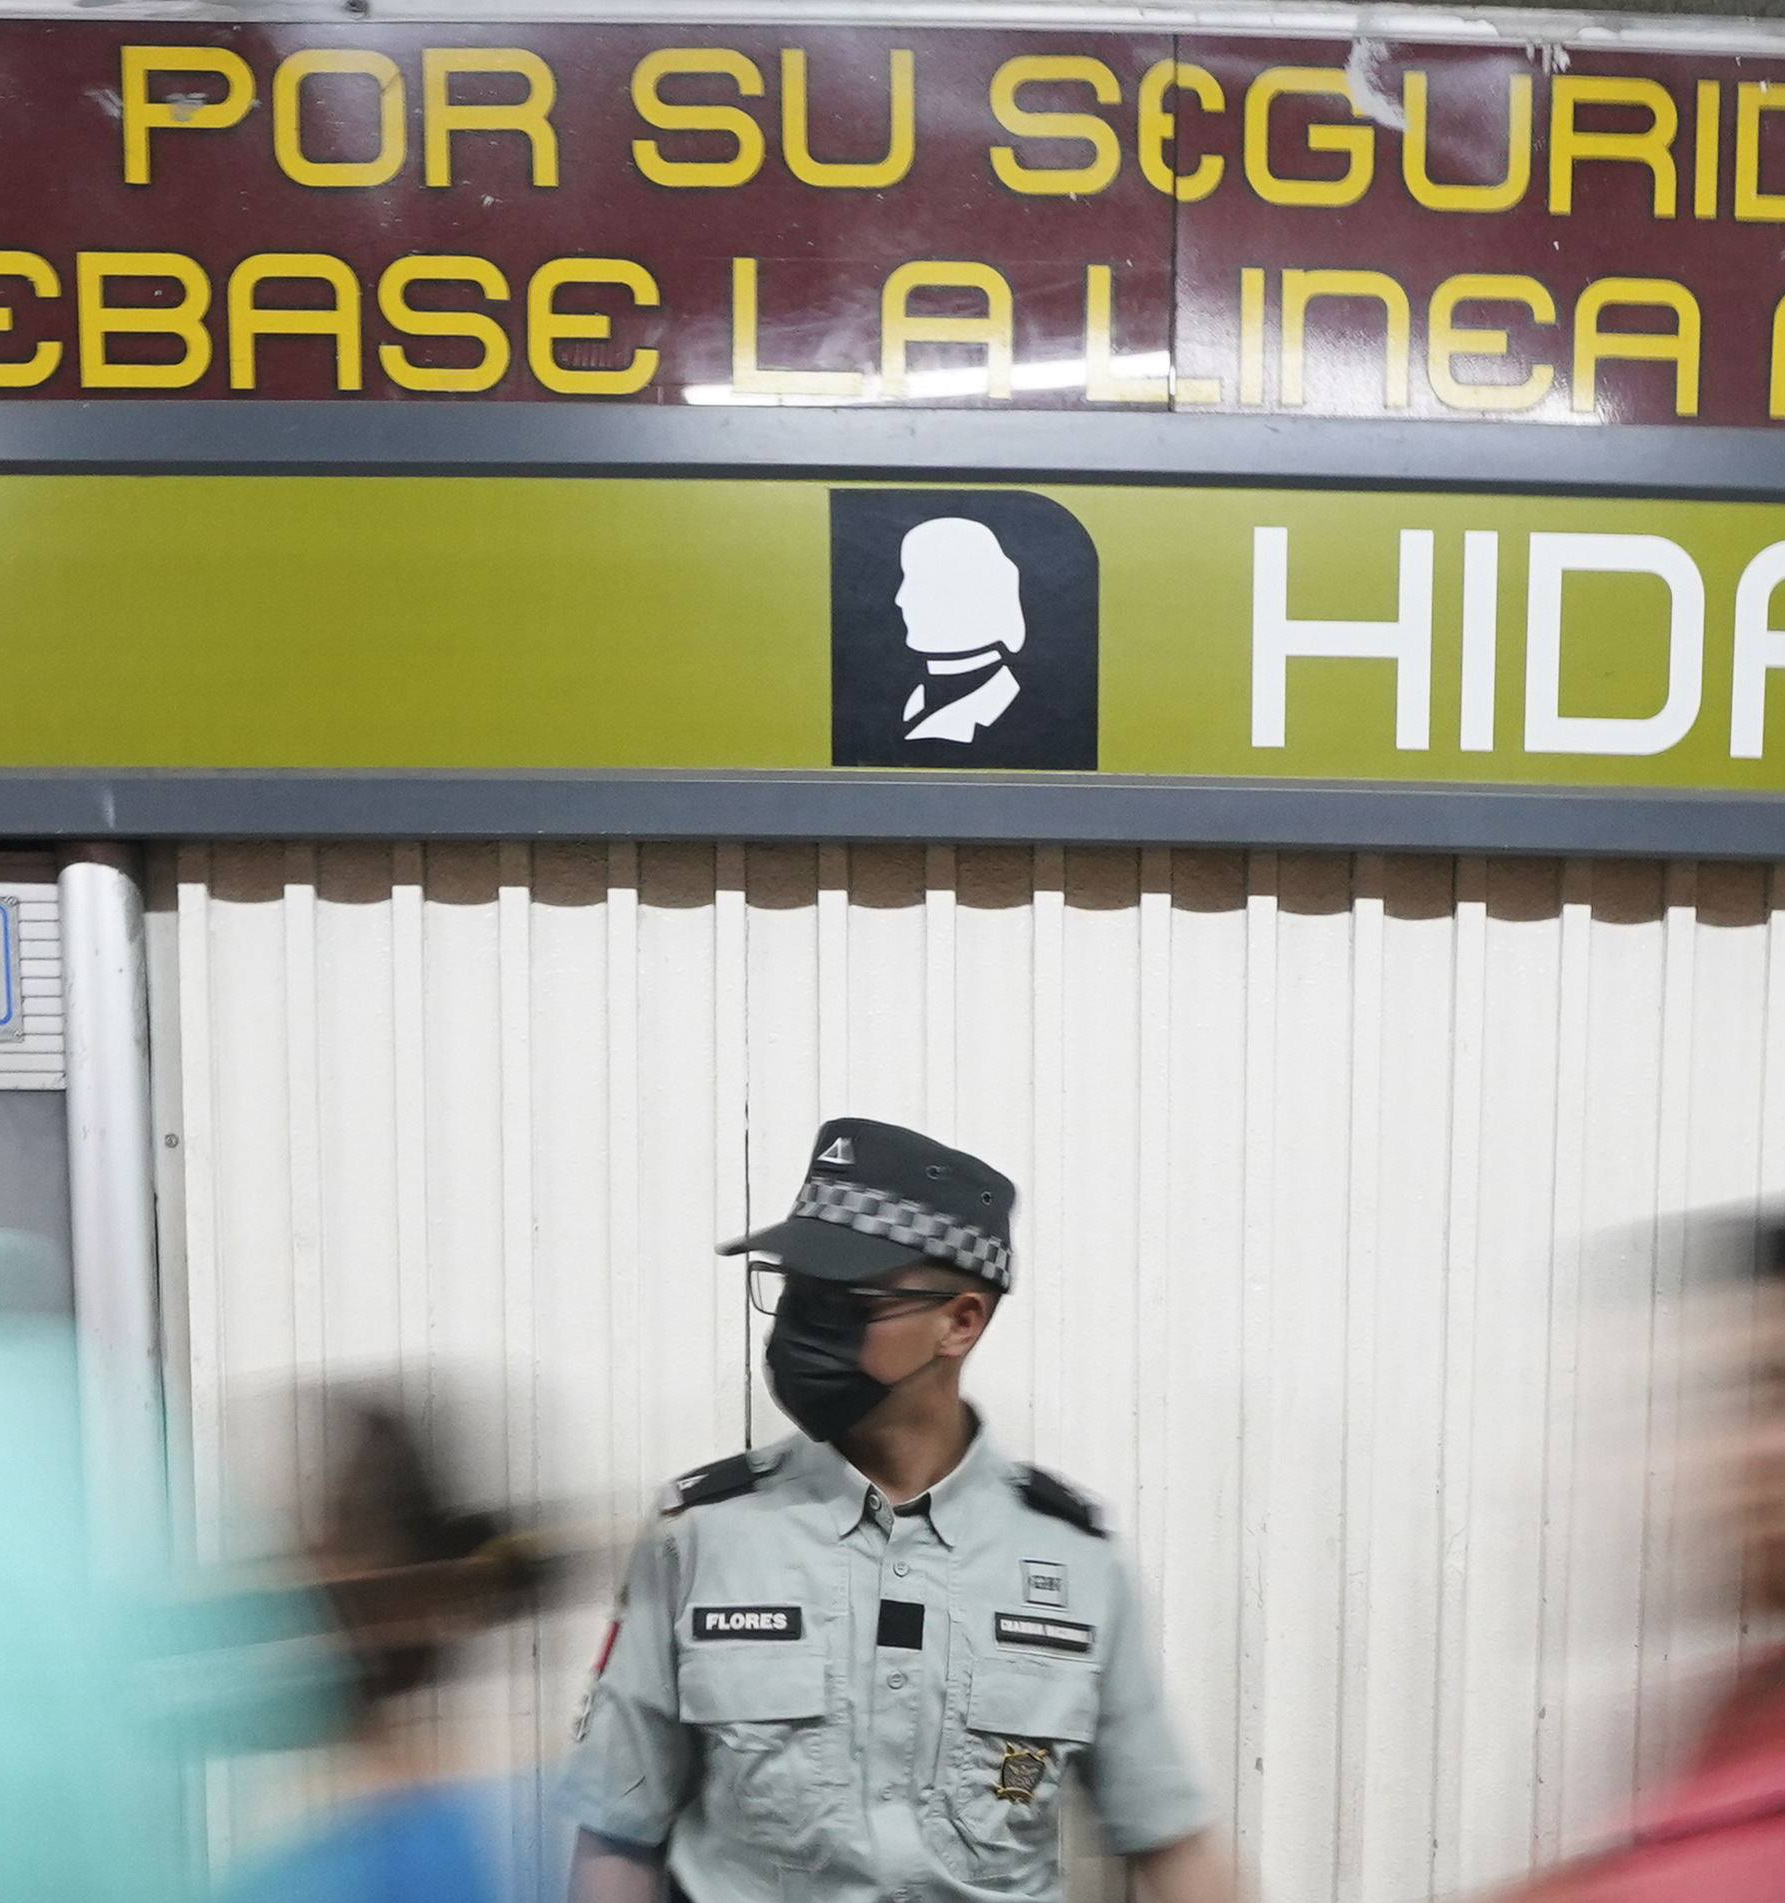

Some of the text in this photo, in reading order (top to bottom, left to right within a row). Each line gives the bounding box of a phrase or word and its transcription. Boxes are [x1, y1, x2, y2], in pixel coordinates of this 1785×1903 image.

[123, 44, 559, 188] POR
[630, 46, 916, 190] SU
[731, 256, 1013, 401] LA
[1083, 263, 1703, 420] LINEA
[705, 1611, 788, 1632] FLORES
